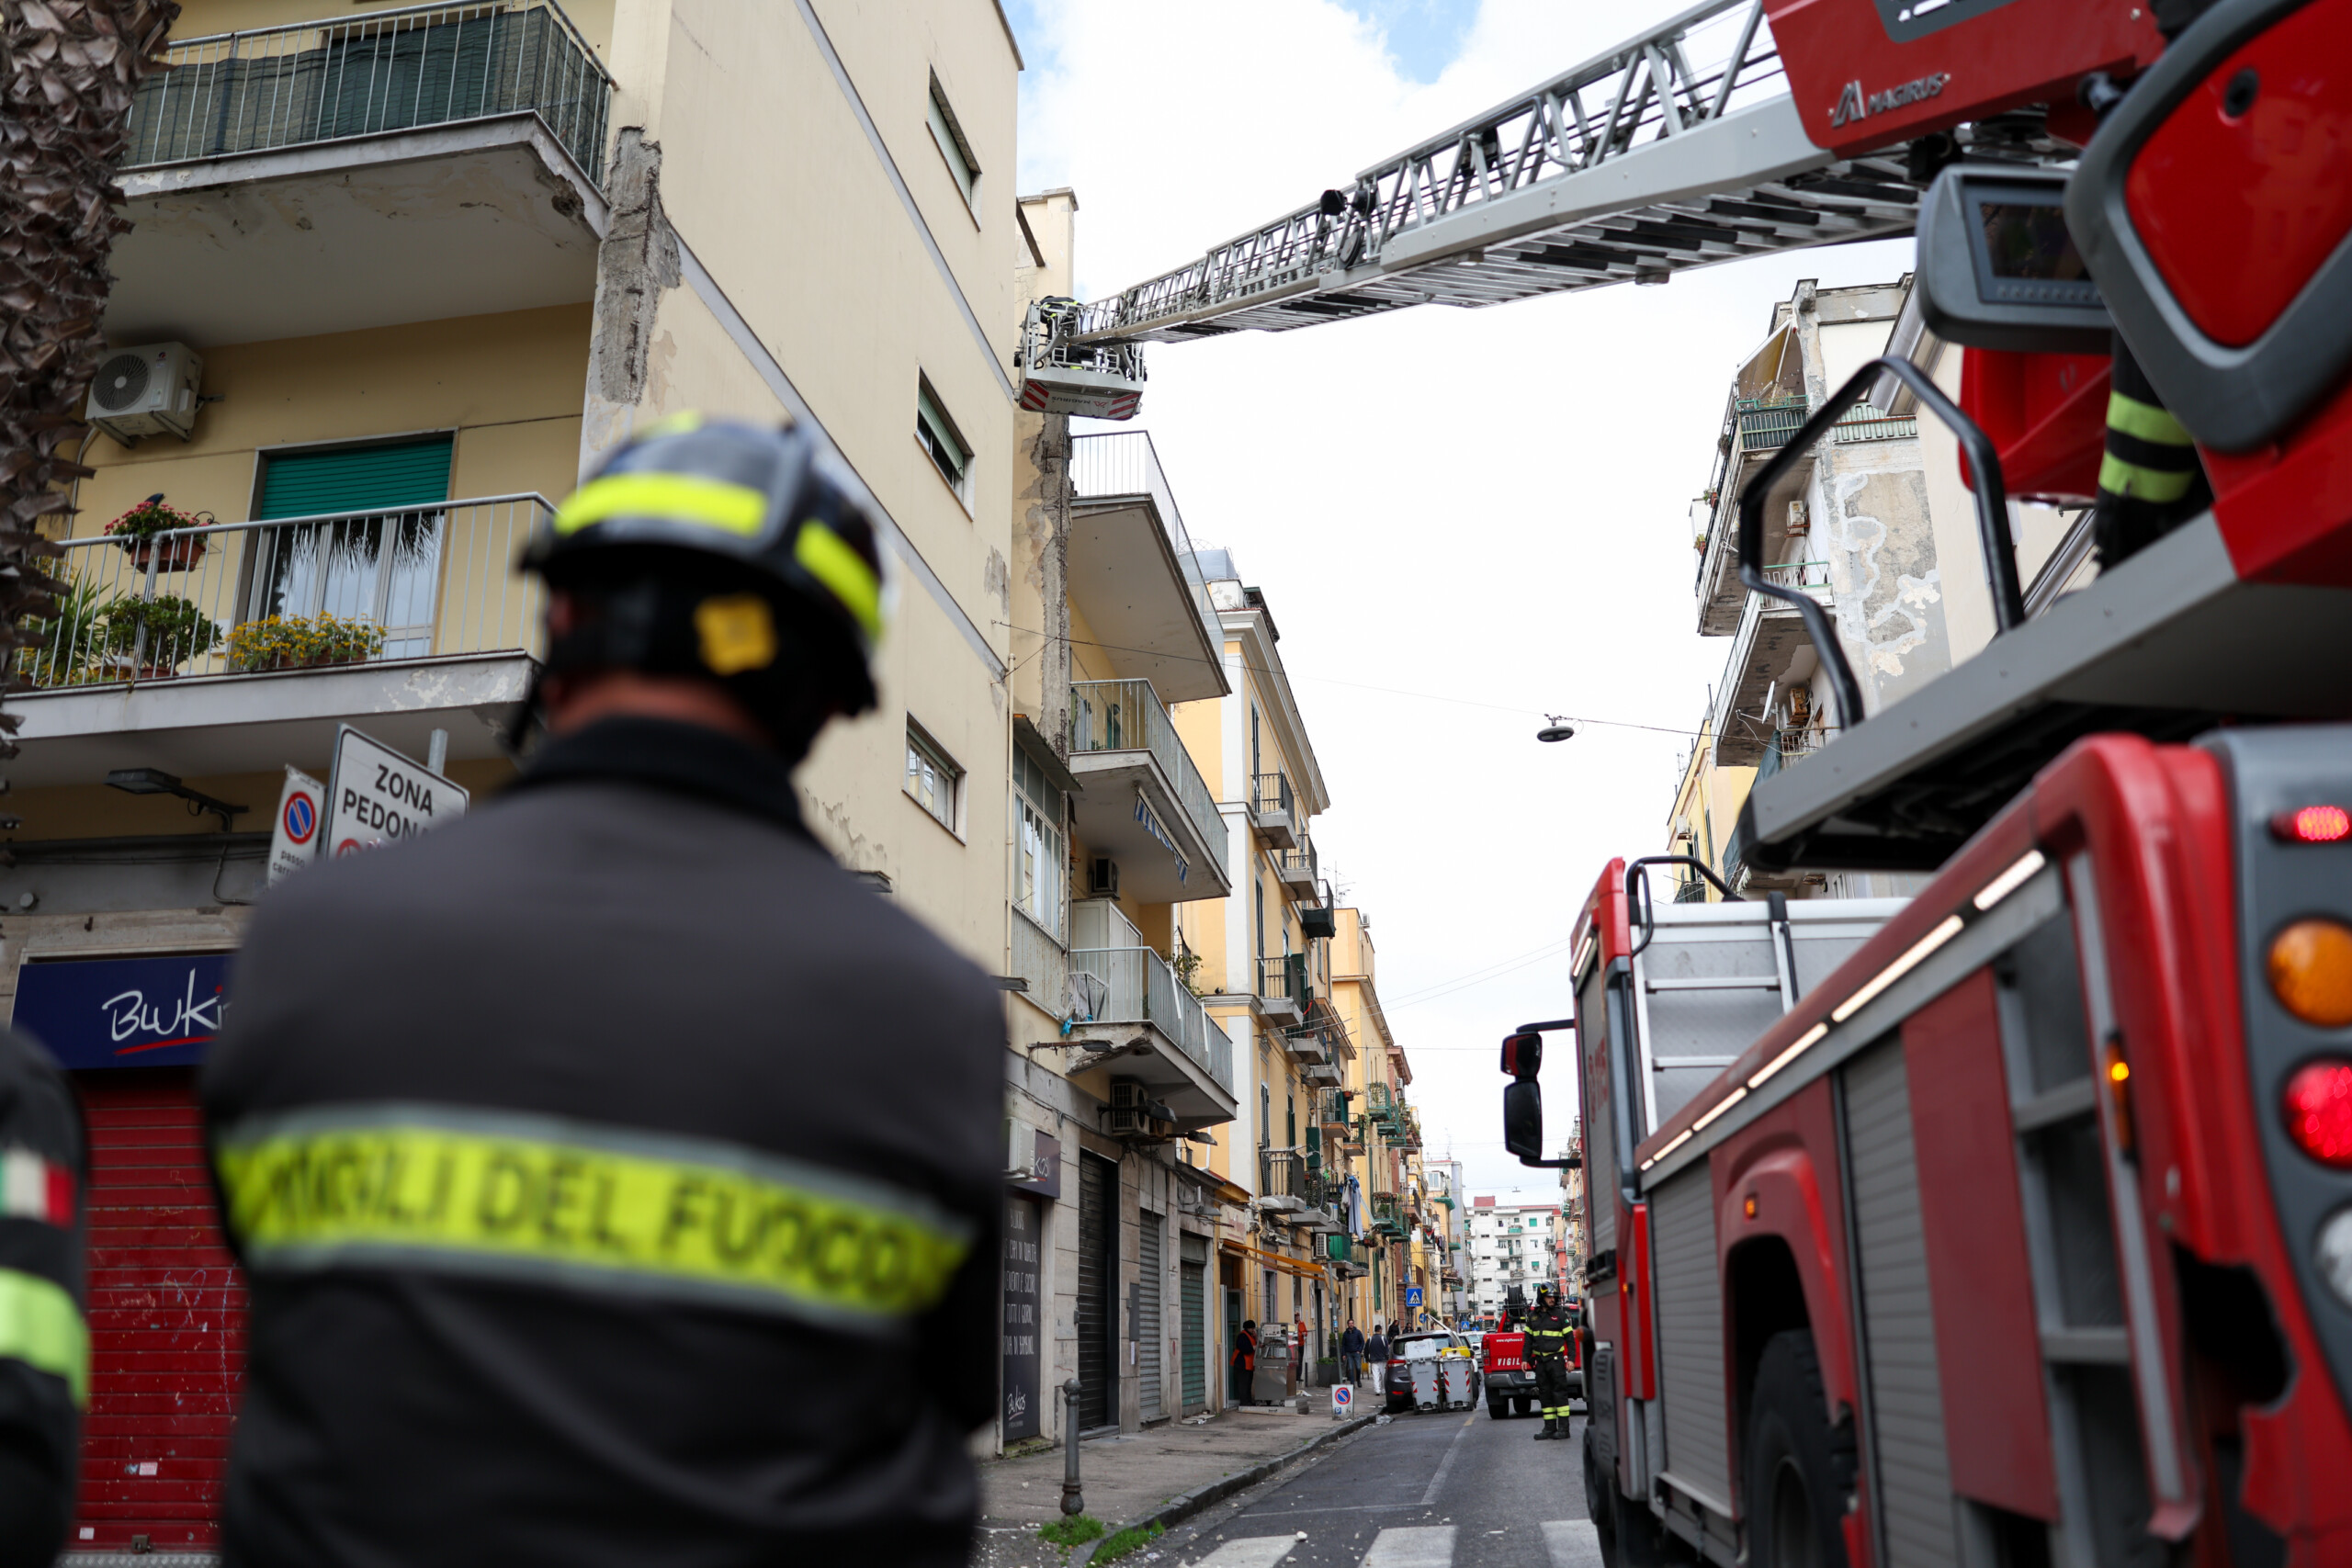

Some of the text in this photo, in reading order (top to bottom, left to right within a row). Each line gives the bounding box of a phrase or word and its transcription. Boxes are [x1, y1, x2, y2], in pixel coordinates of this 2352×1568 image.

[1868, 71, 1944, 116] MAGIRUS
[1051, 396, 1091, 404] MAGIRUS
[374, 763, 433, 818] ZONA
[342, 787, 428, 840] PEDON
[280, 850, 305, 869] passo
[475, 1151, 634, 1251] DEL
[656, 1176, 919, 1303] FUOCO
[1498, 1358, 1521, 1366] VIGIL
